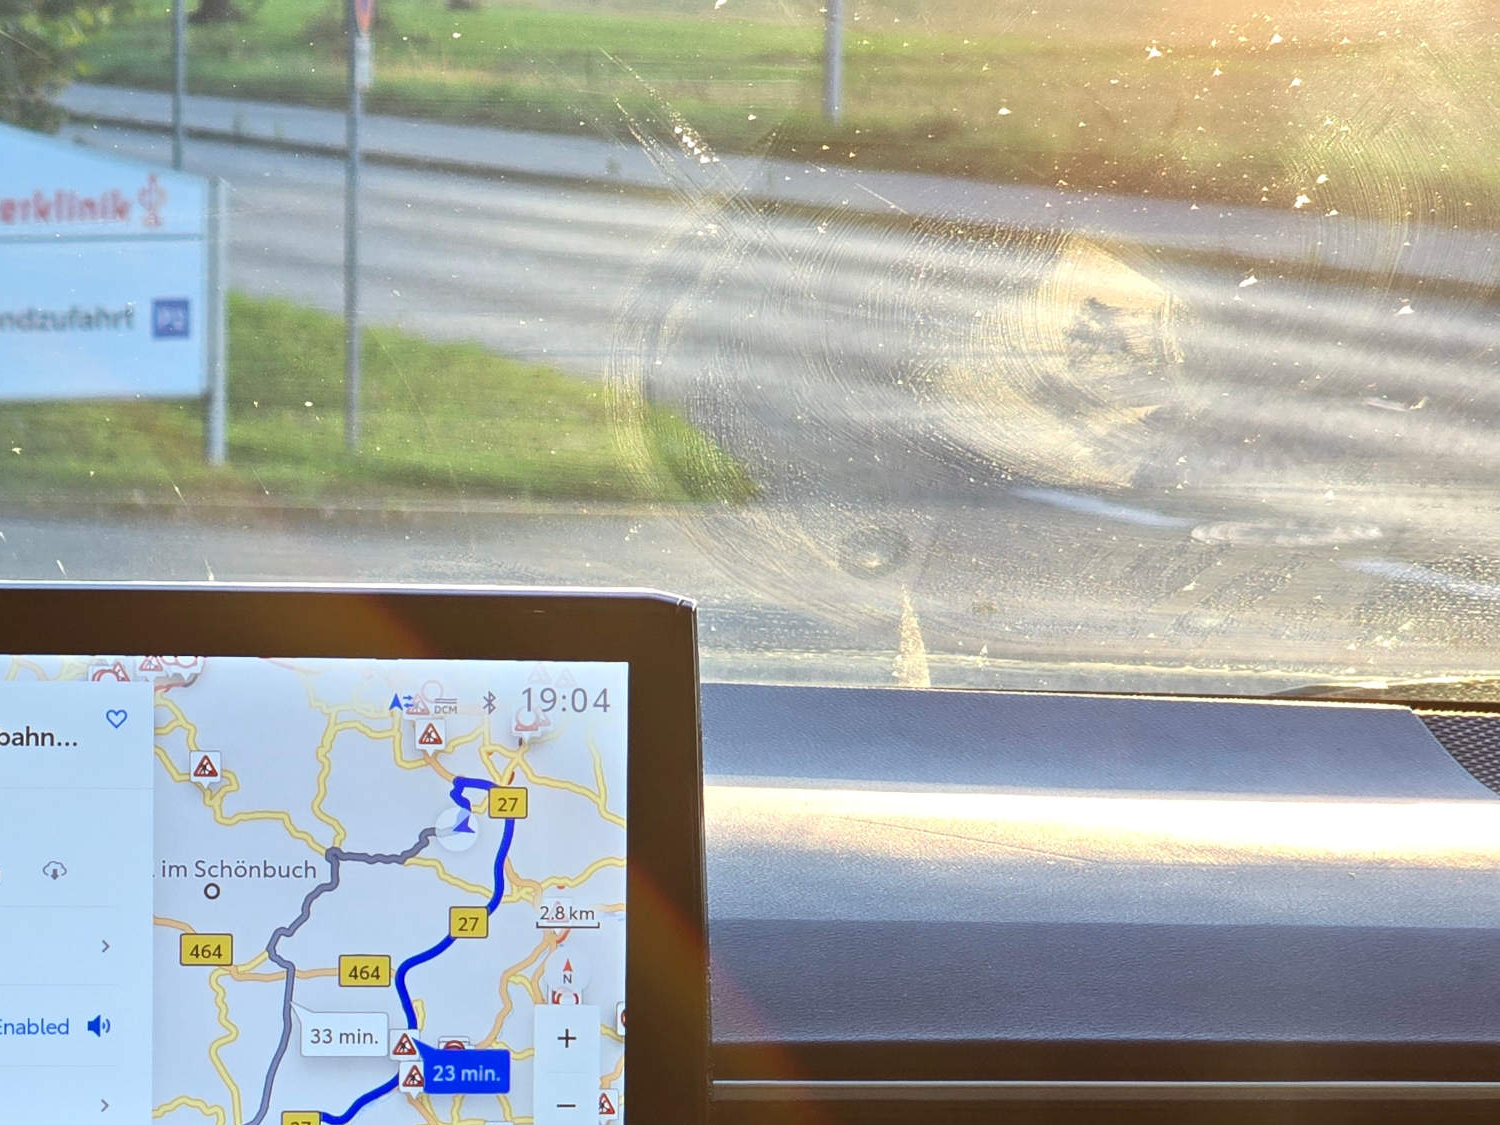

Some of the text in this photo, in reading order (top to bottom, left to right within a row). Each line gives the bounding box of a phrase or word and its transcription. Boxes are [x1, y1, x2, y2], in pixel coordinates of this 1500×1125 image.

[522, 687, 610, 713] 19:04
[434, 704, 457, 714] DCM
[498, 797, 517, 812] 27
[161, 859, 317, 879] im Schönbuch
[459, 916, 479, 932] 27
[189, 943, 222, 959] 464
[348, 964, 381, 980] 464
[310, 1029, 378, 1045] 33 min.
[433, 1064, 500, 1081] 23 min.
